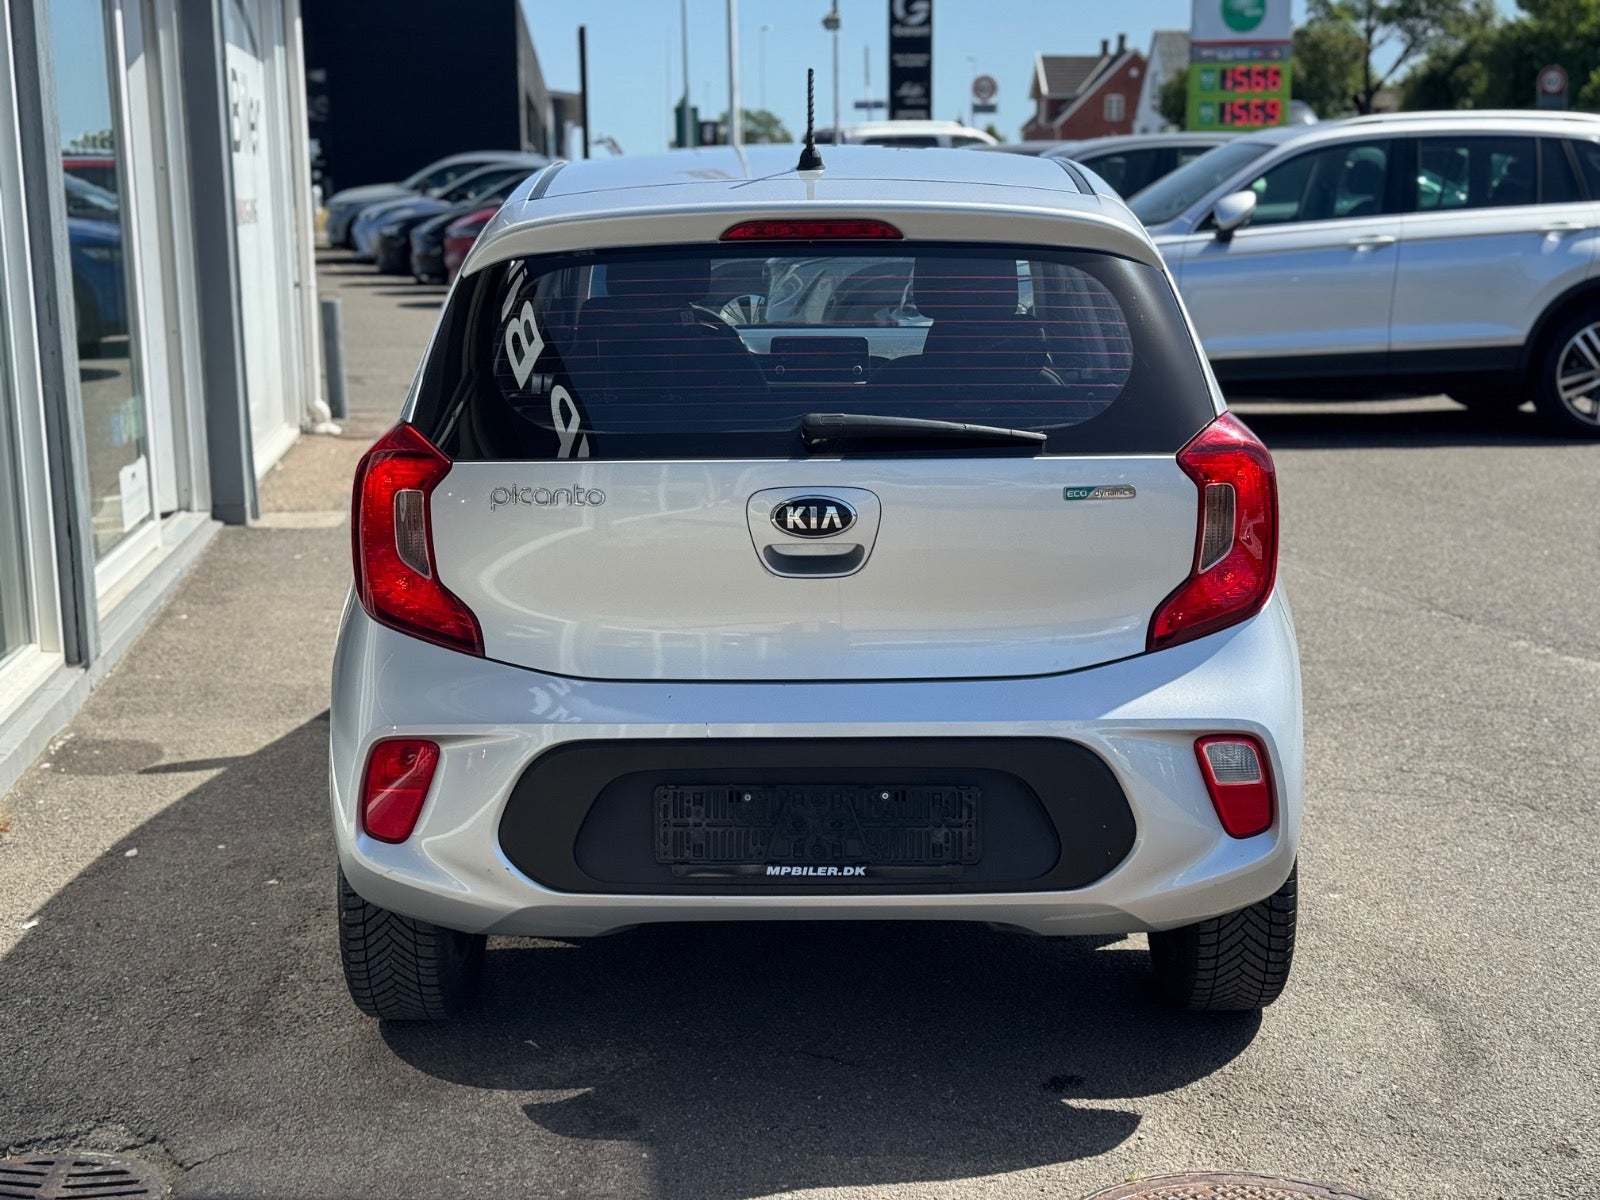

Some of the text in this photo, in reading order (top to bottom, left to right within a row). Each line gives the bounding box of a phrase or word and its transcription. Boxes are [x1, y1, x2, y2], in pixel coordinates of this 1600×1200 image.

[490, 483, 607, 512] picanto
[1067, 487, 1134, 499] ECO dynamics
[786, 506, 843, 529] KIA
[766, 865, 867, 876] MPBILER.DK
